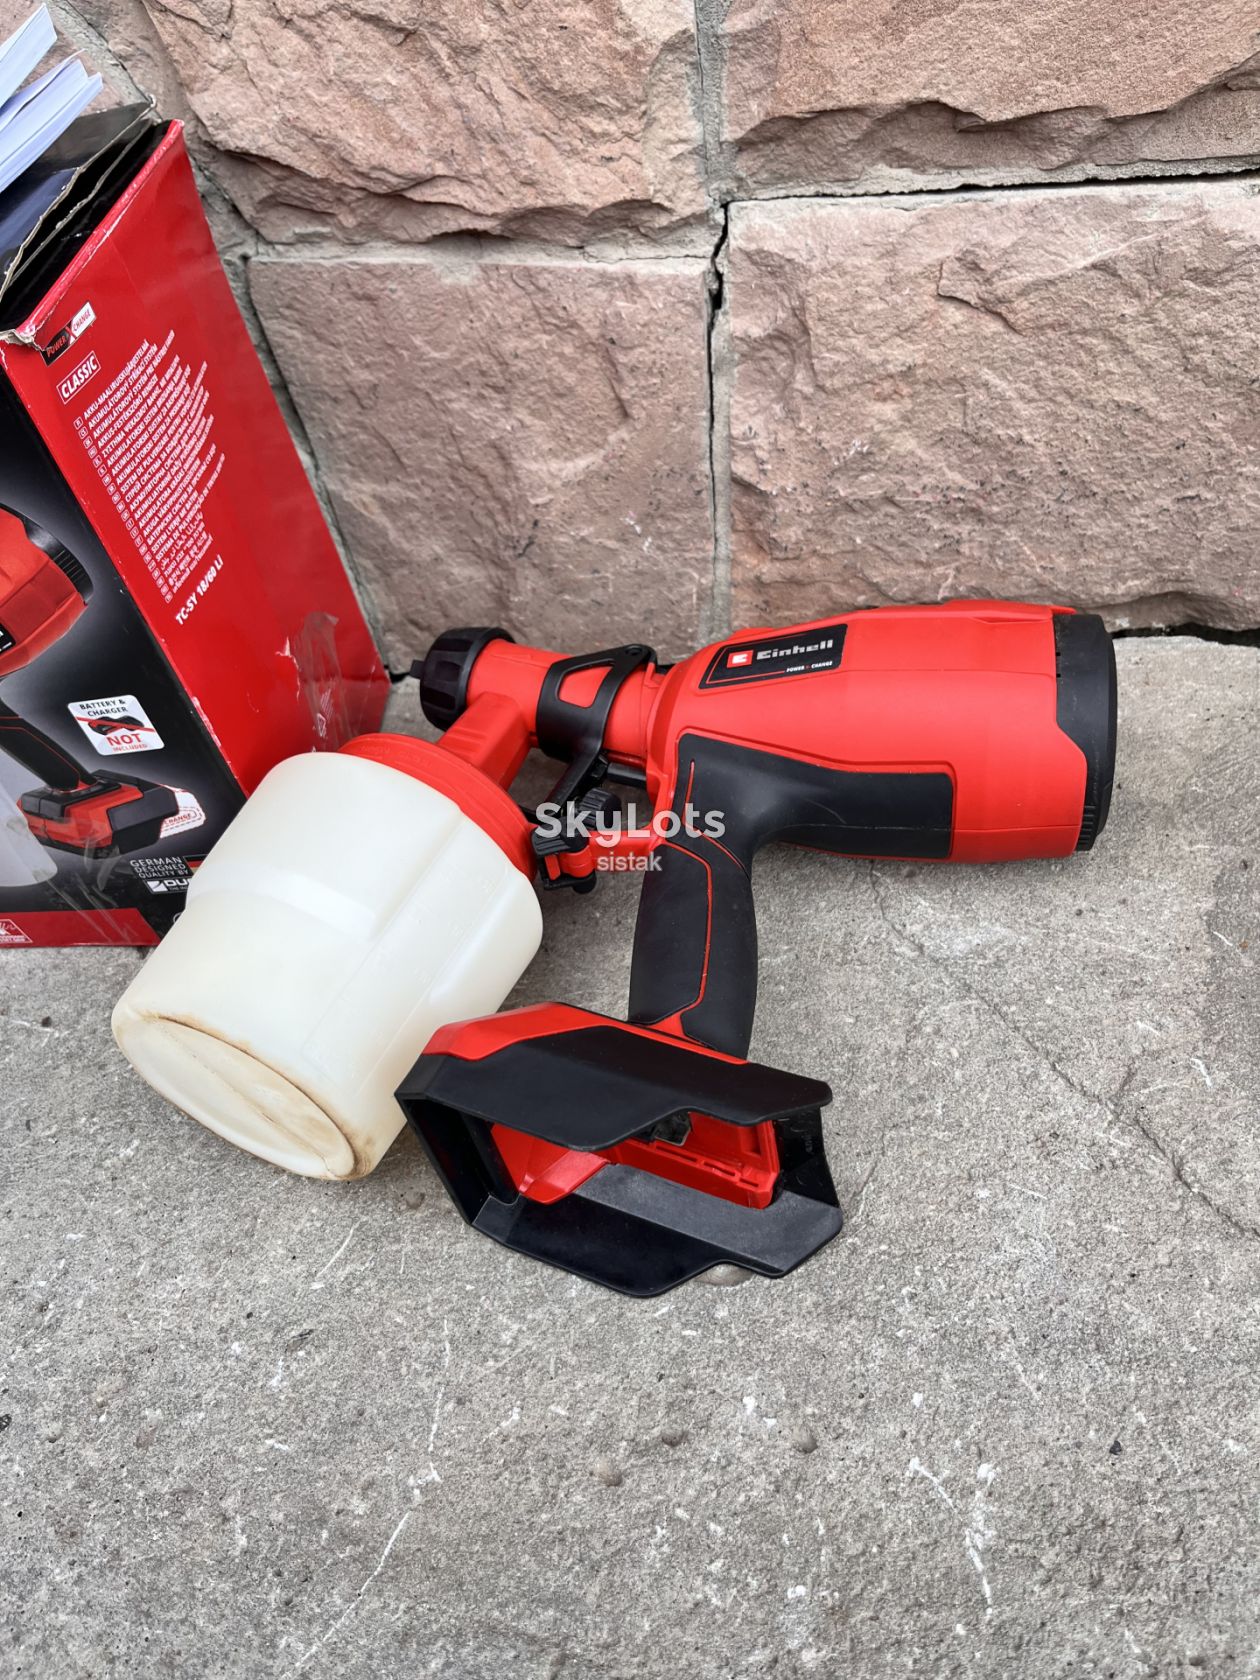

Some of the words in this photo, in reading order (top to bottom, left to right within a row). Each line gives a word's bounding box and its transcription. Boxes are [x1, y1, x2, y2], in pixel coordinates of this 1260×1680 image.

[61, 356, 98, 398] CLASSIC
[175, 592, 198, 625] TC-SY
[196, 565, 217, 596] 18/60
[756, 639, 834, 661] Einhell
[786, 665, 805, 673] POWER
[811, 660, 833, 669] CHANGE
[79, 700, 116, 710] BATTERY
[87, 706, 128, 717] CHARGER
[106, 733, 142, 746] NOT
[130, 857, 182, 867] GERMAN
[134, 863, 186, 873] DESIGNED
[138, 870, 175, 879] QUALITY
